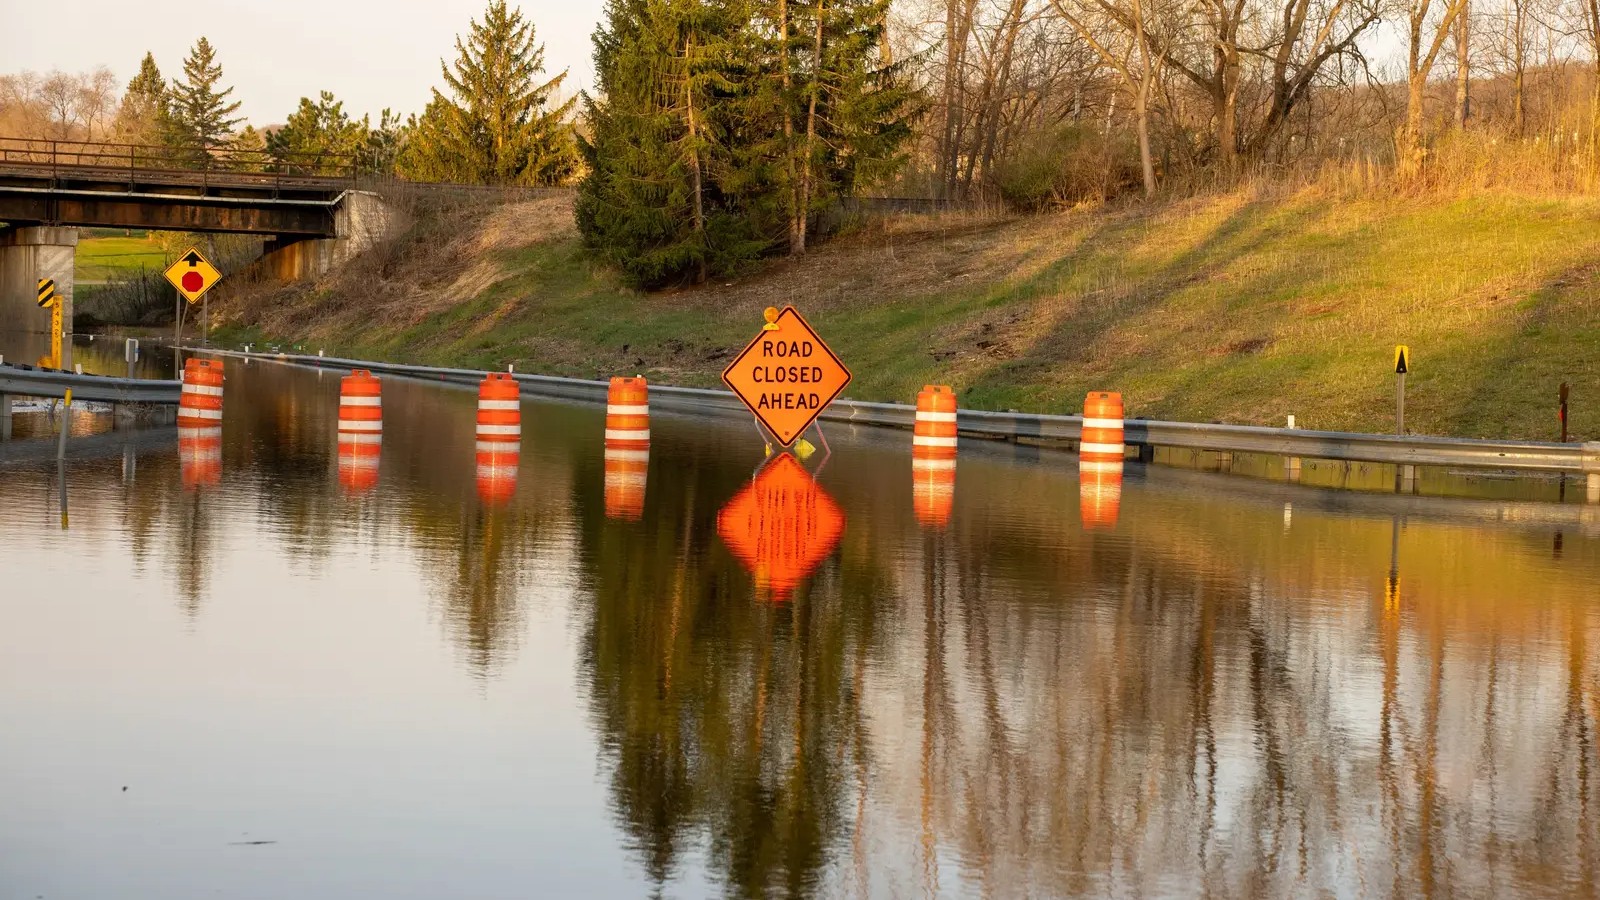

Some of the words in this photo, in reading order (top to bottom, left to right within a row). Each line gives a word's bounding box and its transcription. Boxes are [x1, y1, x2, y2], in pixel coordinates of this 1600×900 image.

[763, 341, 813, 357] ROAD
[752, 366, 823, 383] CLOSED
[757, 393, 820, 409] AHEAD
